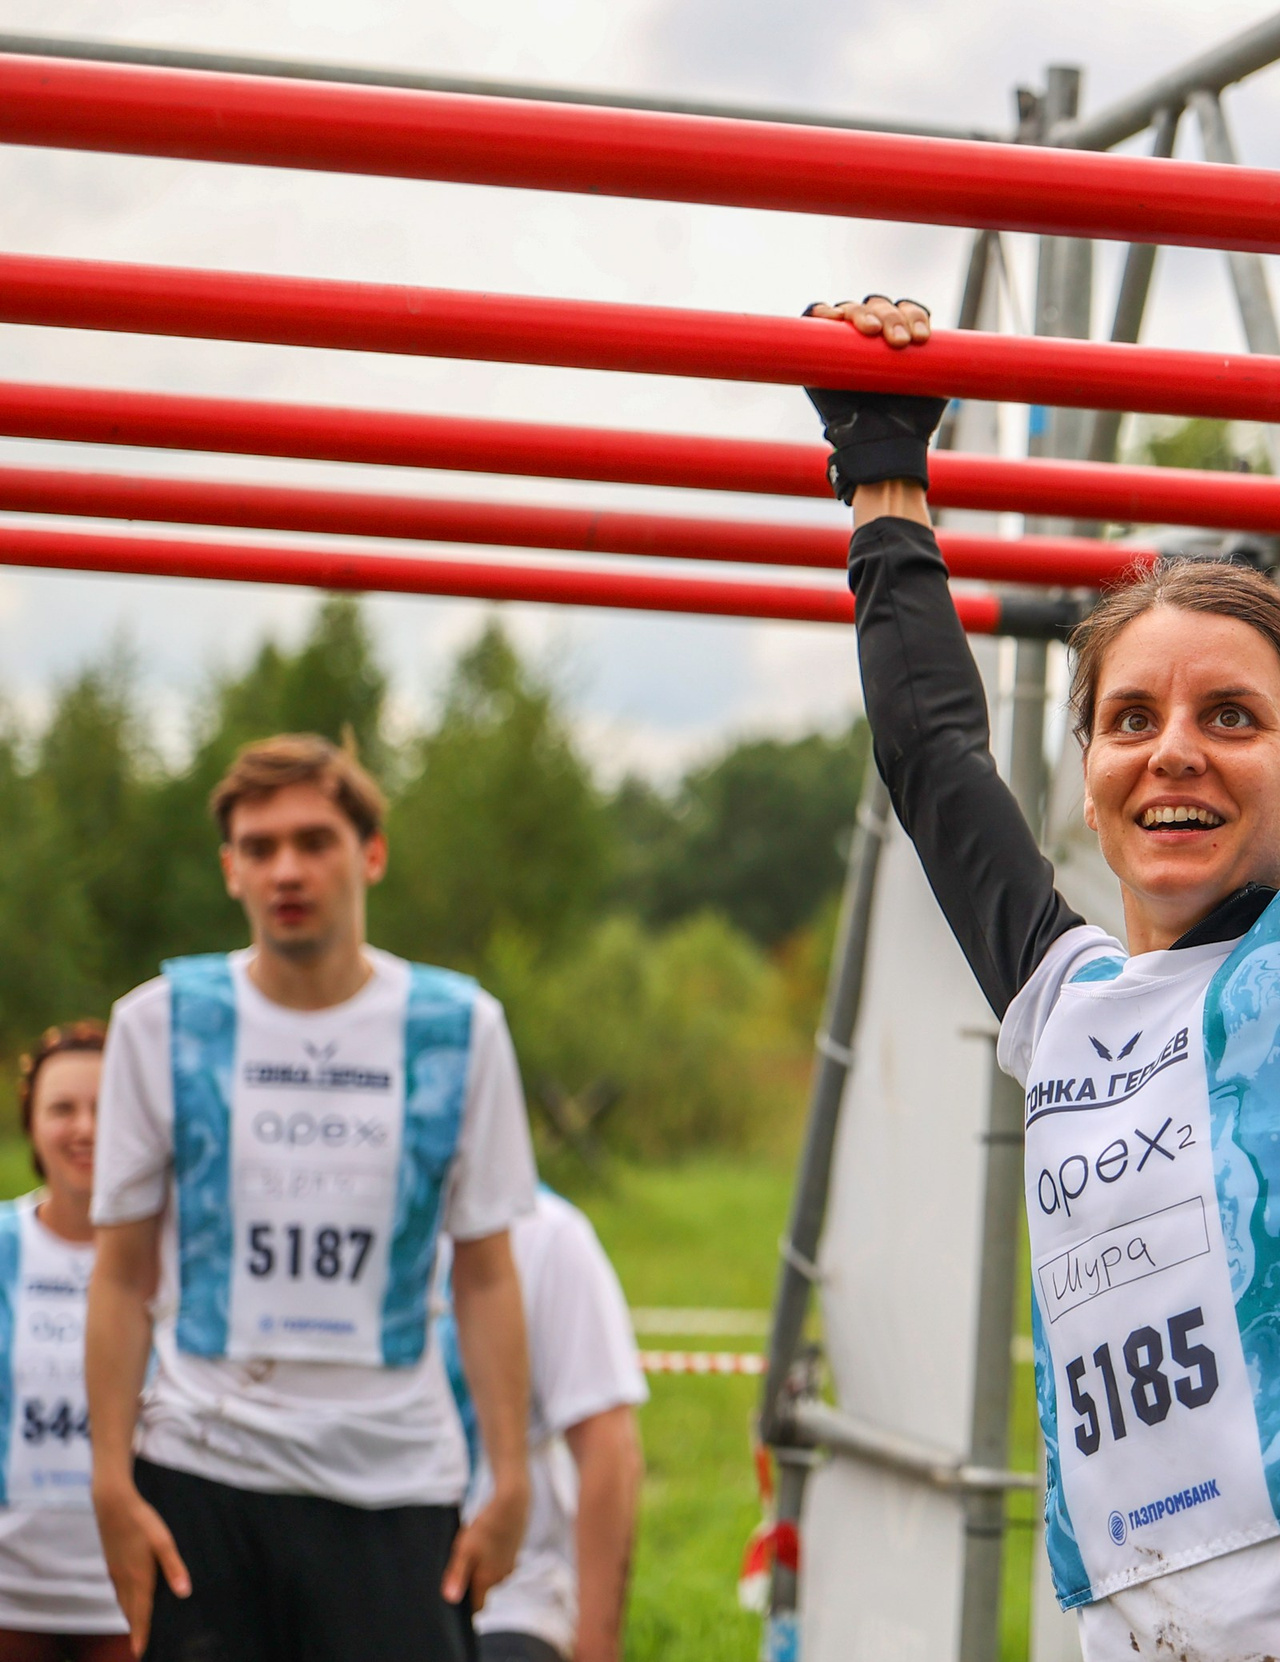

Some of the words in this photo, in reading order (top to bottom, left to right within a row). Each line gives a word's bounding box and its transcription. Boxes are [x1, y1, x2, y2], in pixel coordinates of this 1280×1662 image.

[248, 1223, 375, 1283] 5187
[1066, 1306, 1219, 1456] 5185
[1128, 1479, 1221, 1532] ГАЗПРОМБАНК
